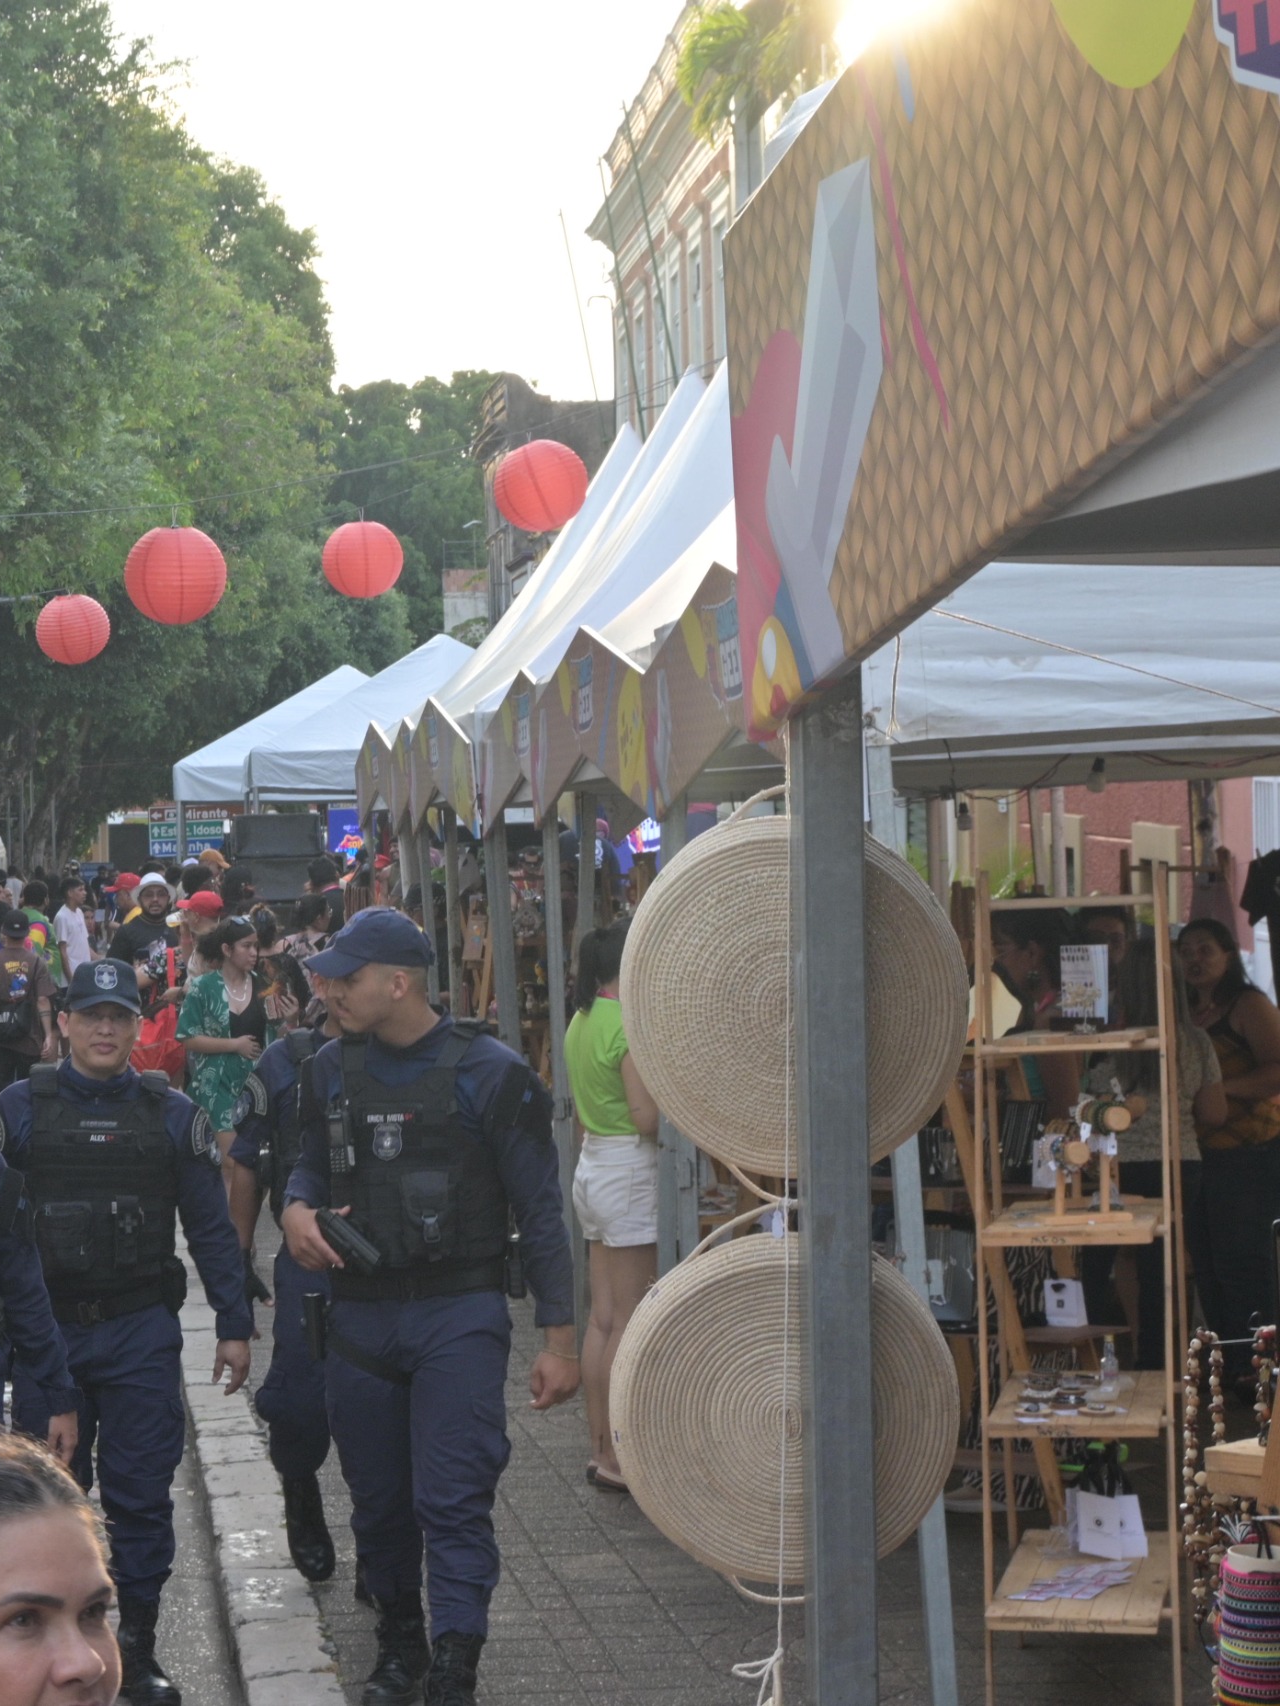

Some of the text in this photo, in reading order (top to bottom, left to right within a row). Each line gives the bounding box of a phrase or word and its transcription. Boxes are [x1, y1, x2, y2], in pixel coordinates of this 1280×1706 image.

[185, 808, 228, 819] Mirante
[194, 825, 222, 835] Idoso
[163, 841, 211, 853] Manha
[367, 1114, 384, 1123] ERICK
[386, 1113, 404, 1122] MOTA
[90, 1134, 106, 1142] ALEX
